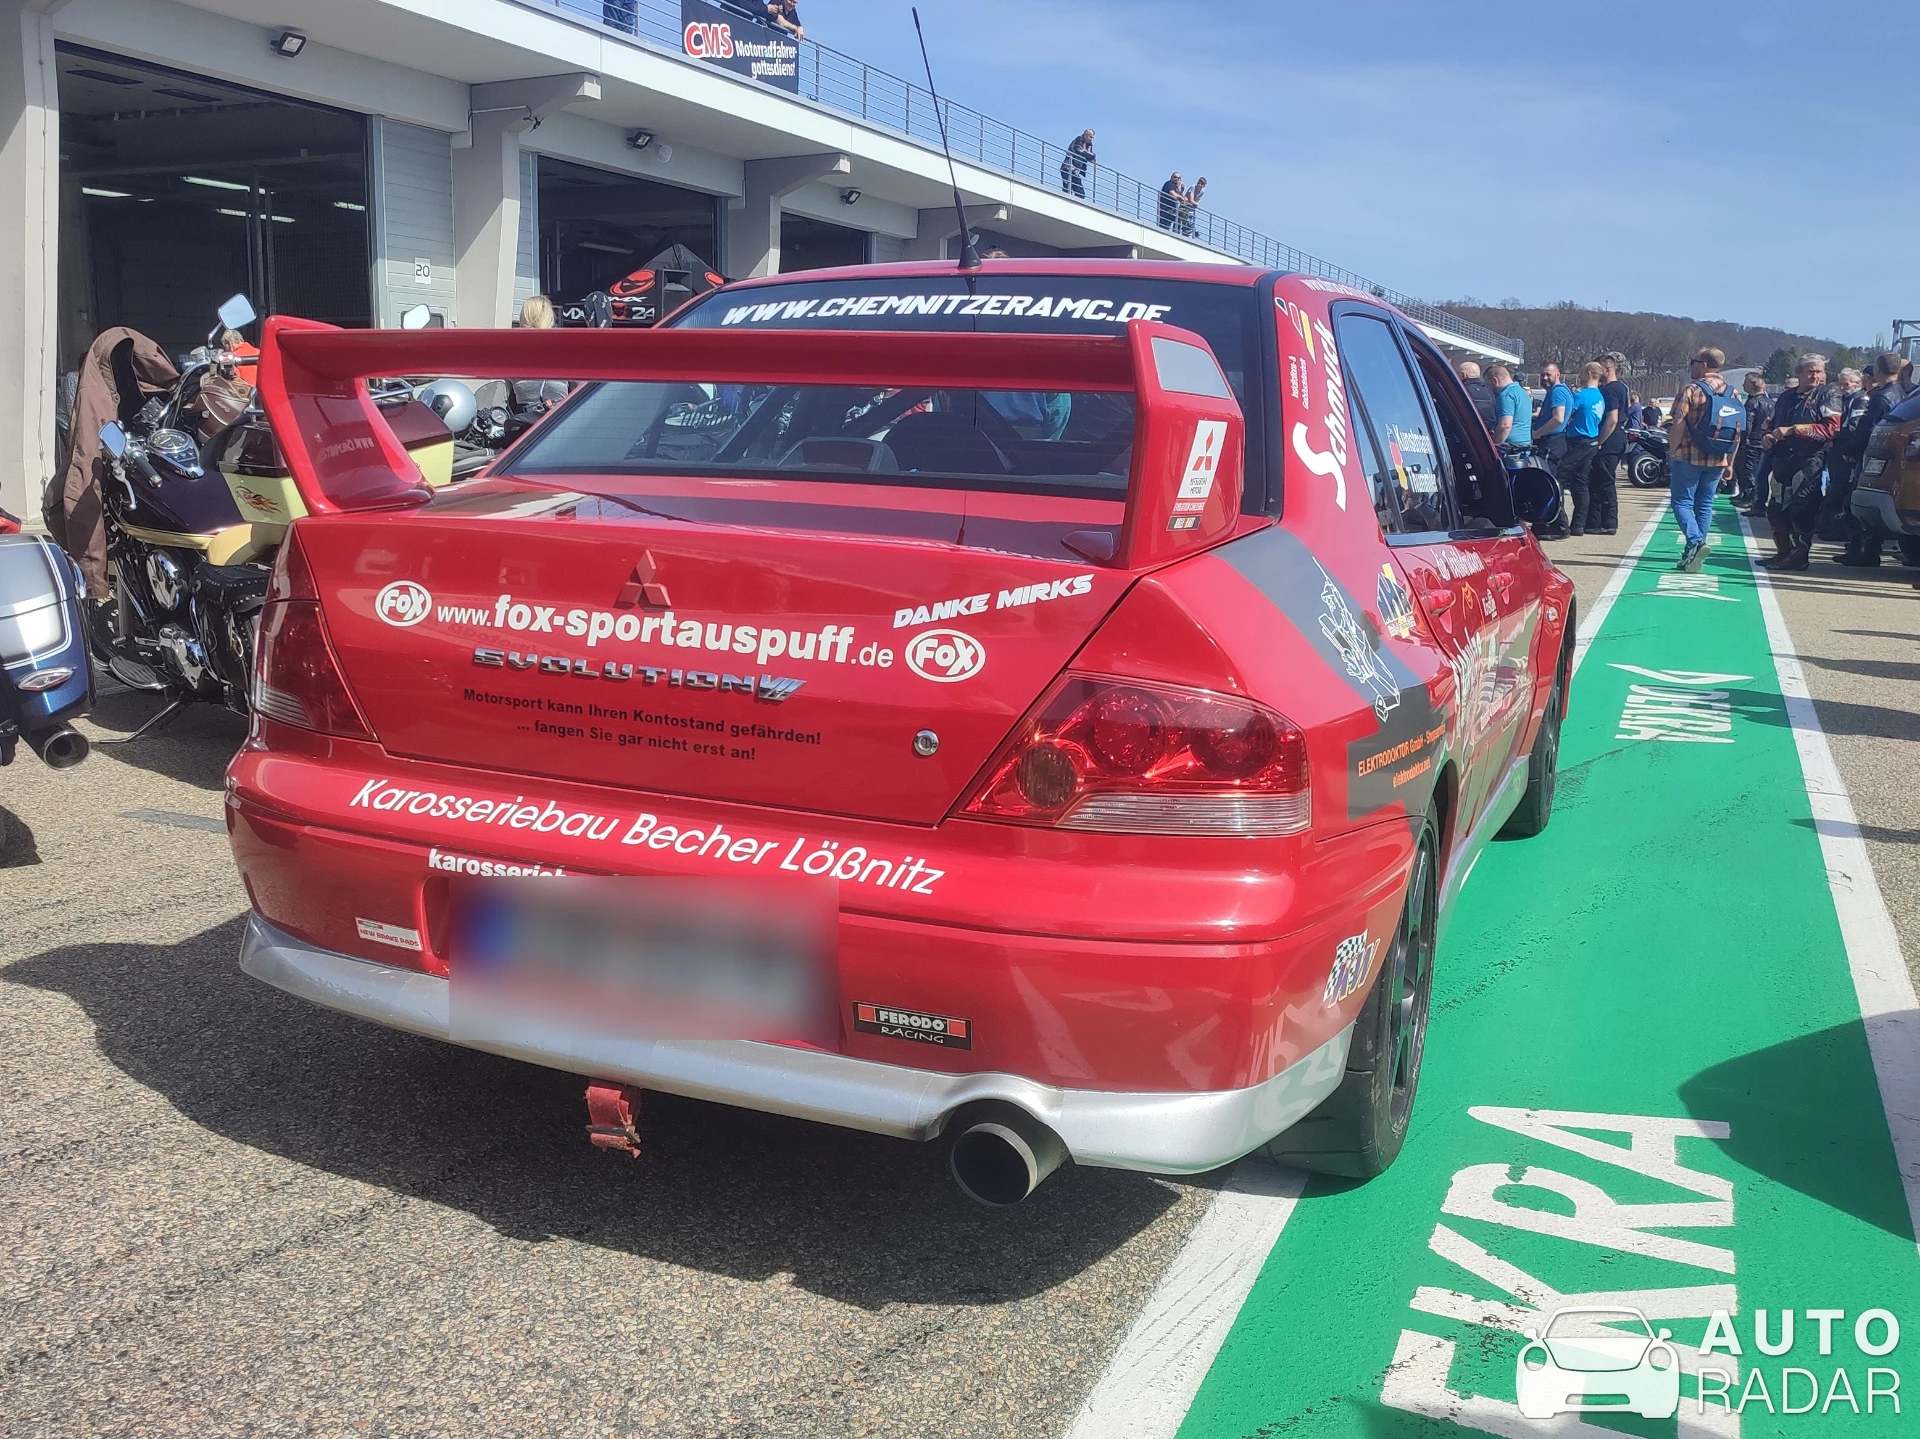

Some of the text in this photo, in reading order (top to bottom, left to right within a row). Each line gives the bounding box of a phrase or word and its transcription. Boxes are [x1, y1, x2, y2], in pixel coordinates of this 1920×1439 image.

[684, 22, 734, 58] CMS
[735, 40, 797, 59] Motorradfahrer-
[751, 59, 796, 79] gottesdienst
[416, 264, 430, 277] 20
[720, 295, 1172, 327] WWW.CHEMNITZERAMC.DE
[1292, 318, 1347, 512] Schmuck
[893, 573, 1096, 629] DANKE MIRKS
[437, 594, 894, 668] www.fox-sportauspuff.de
[463, 688, 822, 745] Motorsport kann Ihren Kontostand gefährden!
[534, 719, 584, 739] fangen
[589, 727, 613, 742] Sie
[618, 732, 644, 748] gar
[648, 734, 688, 751] nicht
[693, 742, 726, 756] erst
[730, 746, 755, 760] an!
[1358, 743, 1410, 777] ELEKTRODOKTOR
[349, 778, 947, 895] Karosseriebau Becher Lößnitz
[360, 928, 420, 947] NEW BRAKE PADS
[879, 1010, 945, 1031] FERODO
[881, 1026, 945, 1044] RACING
